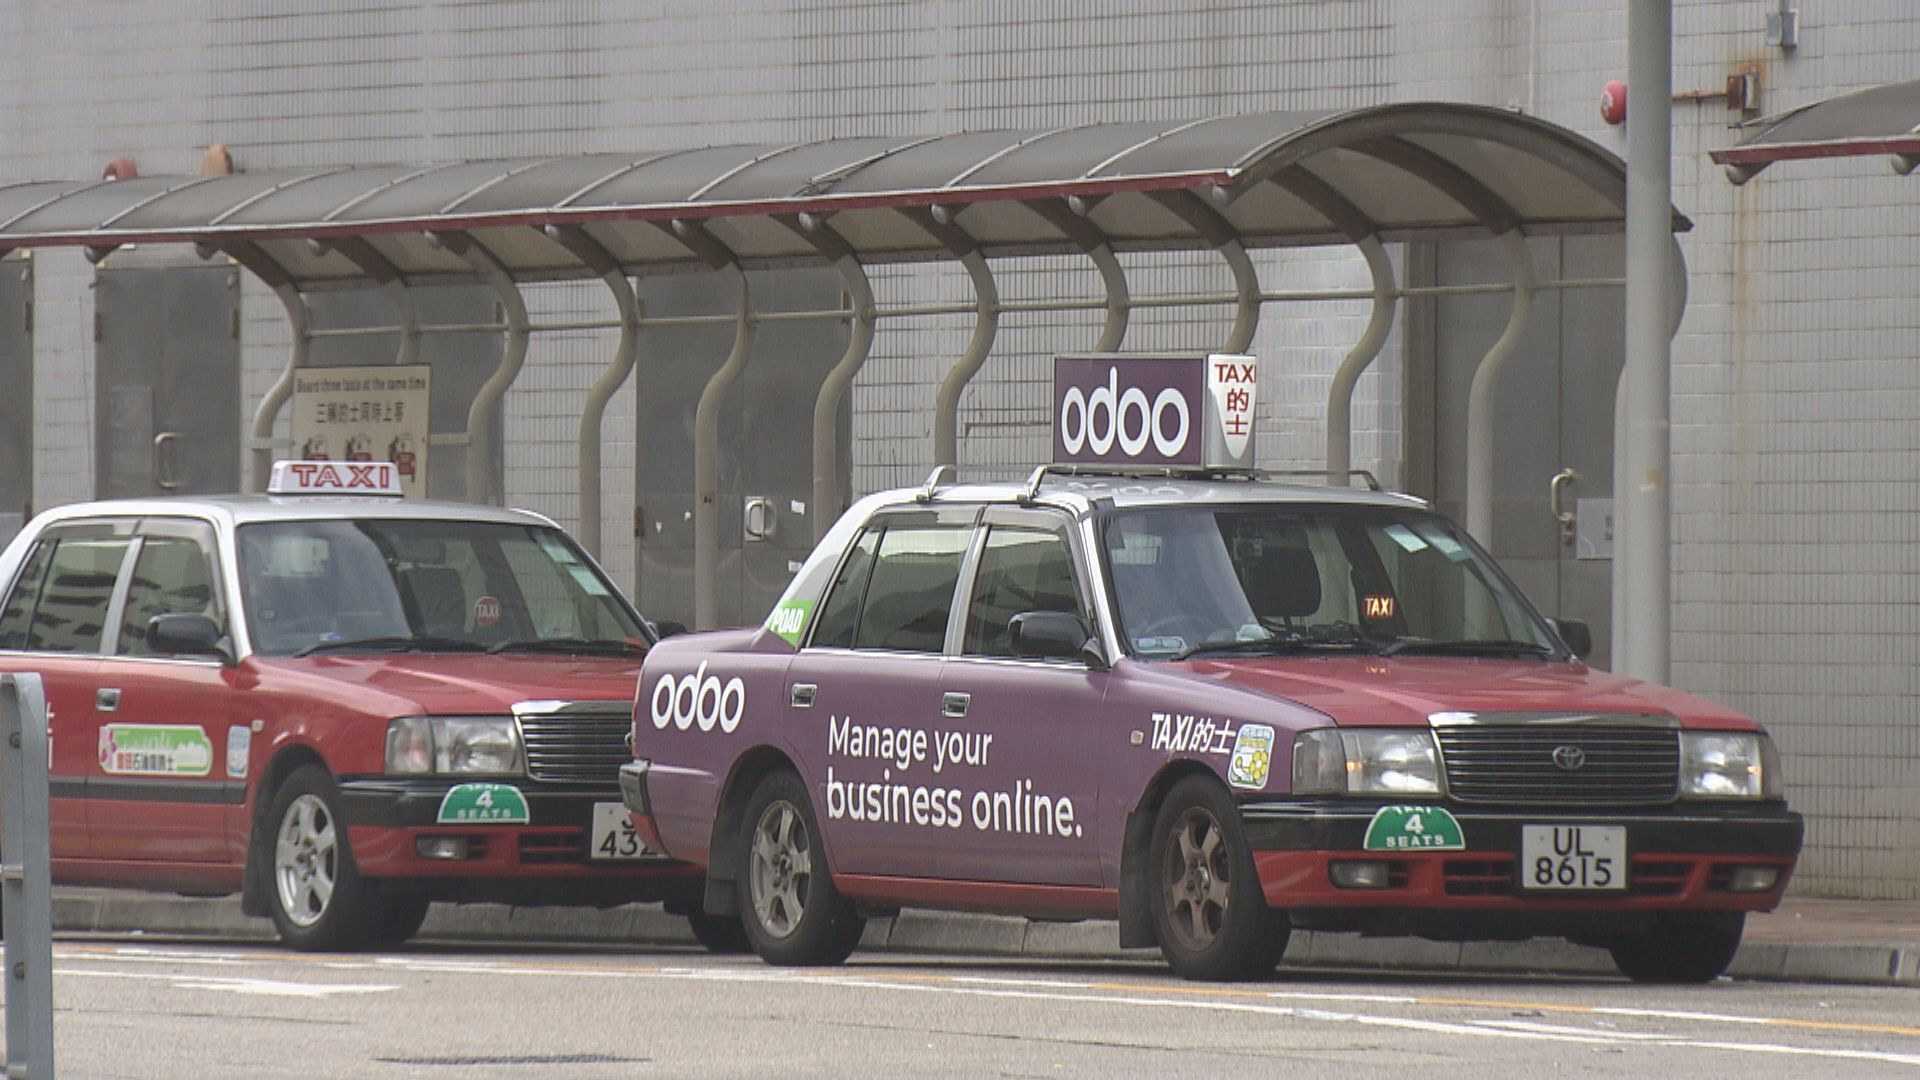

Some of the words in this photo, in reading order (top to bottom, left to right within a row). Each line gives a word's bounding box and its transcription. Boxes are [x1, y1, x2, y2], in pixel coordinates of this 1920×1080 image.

[1214, 363, 1256, 384] TAXI
[1060, 366, 1190, 458] odoo
[1225, 387, 1250, 436] 的士
[291, 464, 390, 489] TAXI
[477, 604, 499, 618] TAXI
[1365, 597, 1394, 617] TAXI
[652, 660, 745, 733] odoo
[828, 714, 928, 771] Manage
[933, 729, 993, 773] your
[475, 790, 494, 808] 4
[827, 766, 963, 828] business
[971, 778, 1083, 838] online.
[456, 808, 512, 819] SEATS
[1404, 814, 1424, 835] 4
[1385, 834, 1445, 848] SEATS
[1553, 827, 1594, 857] UL
[1534, 856, 1613, 887] 8615
